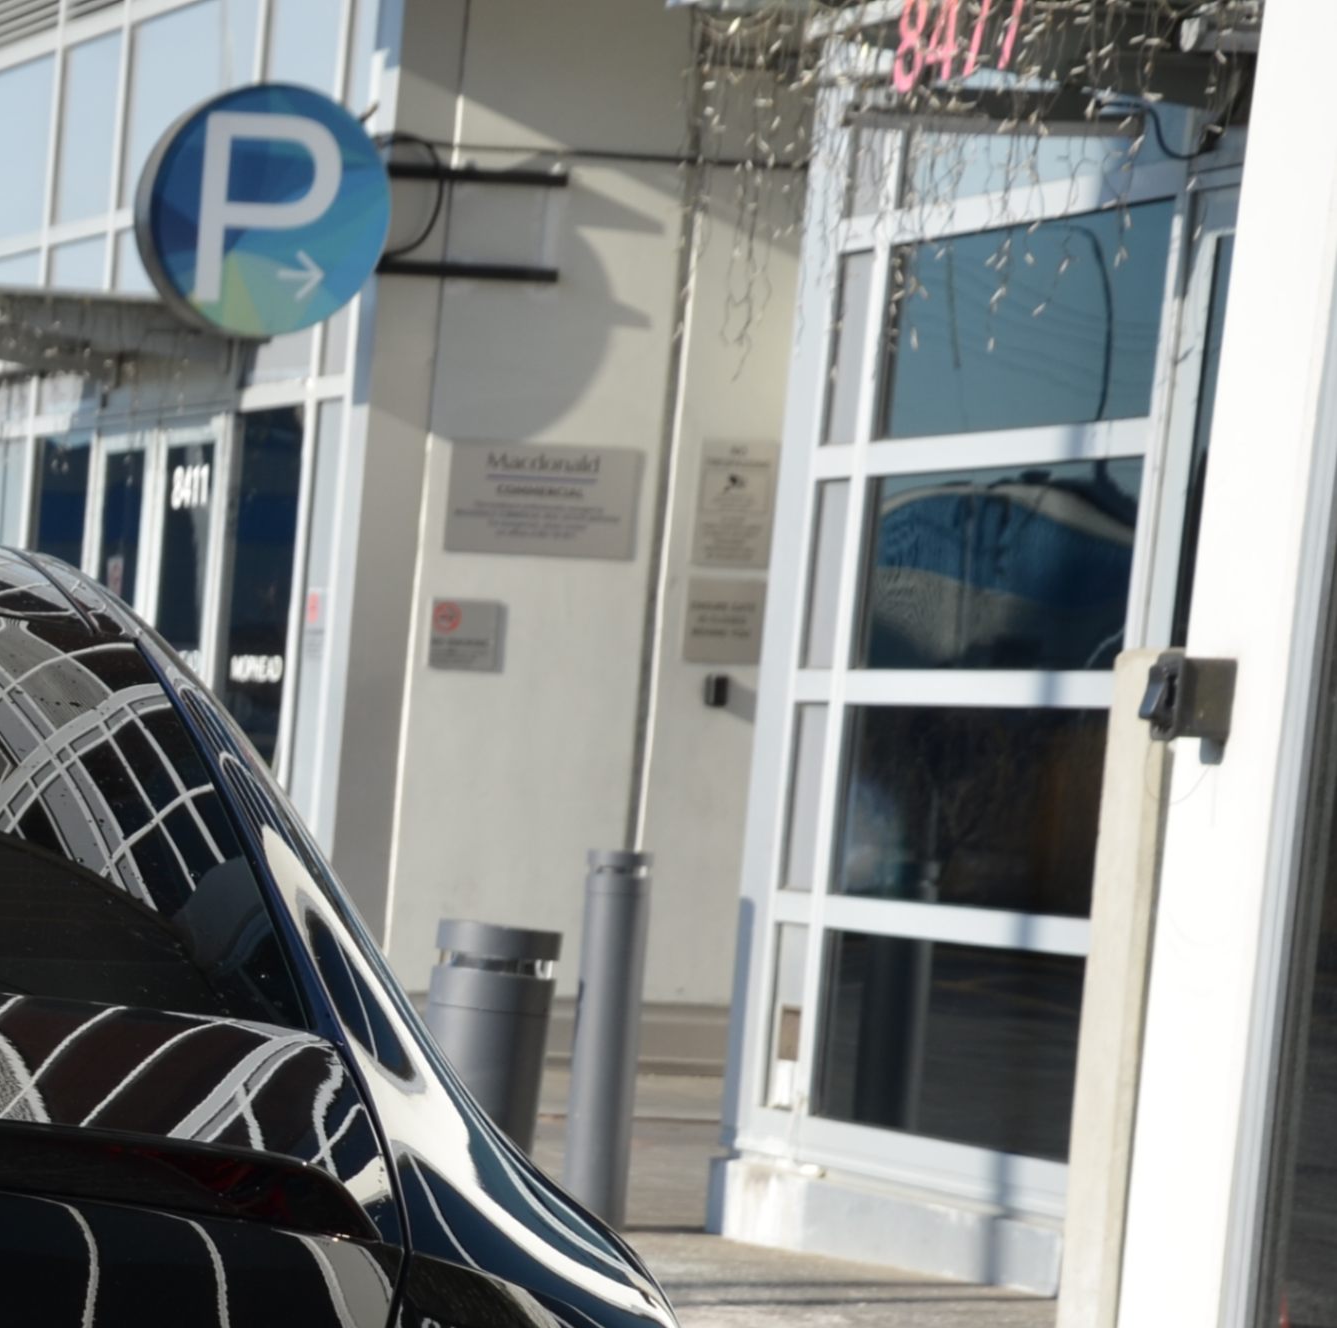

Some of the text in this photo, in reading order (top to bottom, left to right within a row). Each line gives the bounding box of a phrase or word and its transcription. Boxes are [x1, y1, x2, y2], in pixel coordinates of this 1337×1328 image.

[194, 111, 343, 305] P
[486, 452, 602, 474] Macdonald
[171, 464, 211, 511] 8411
